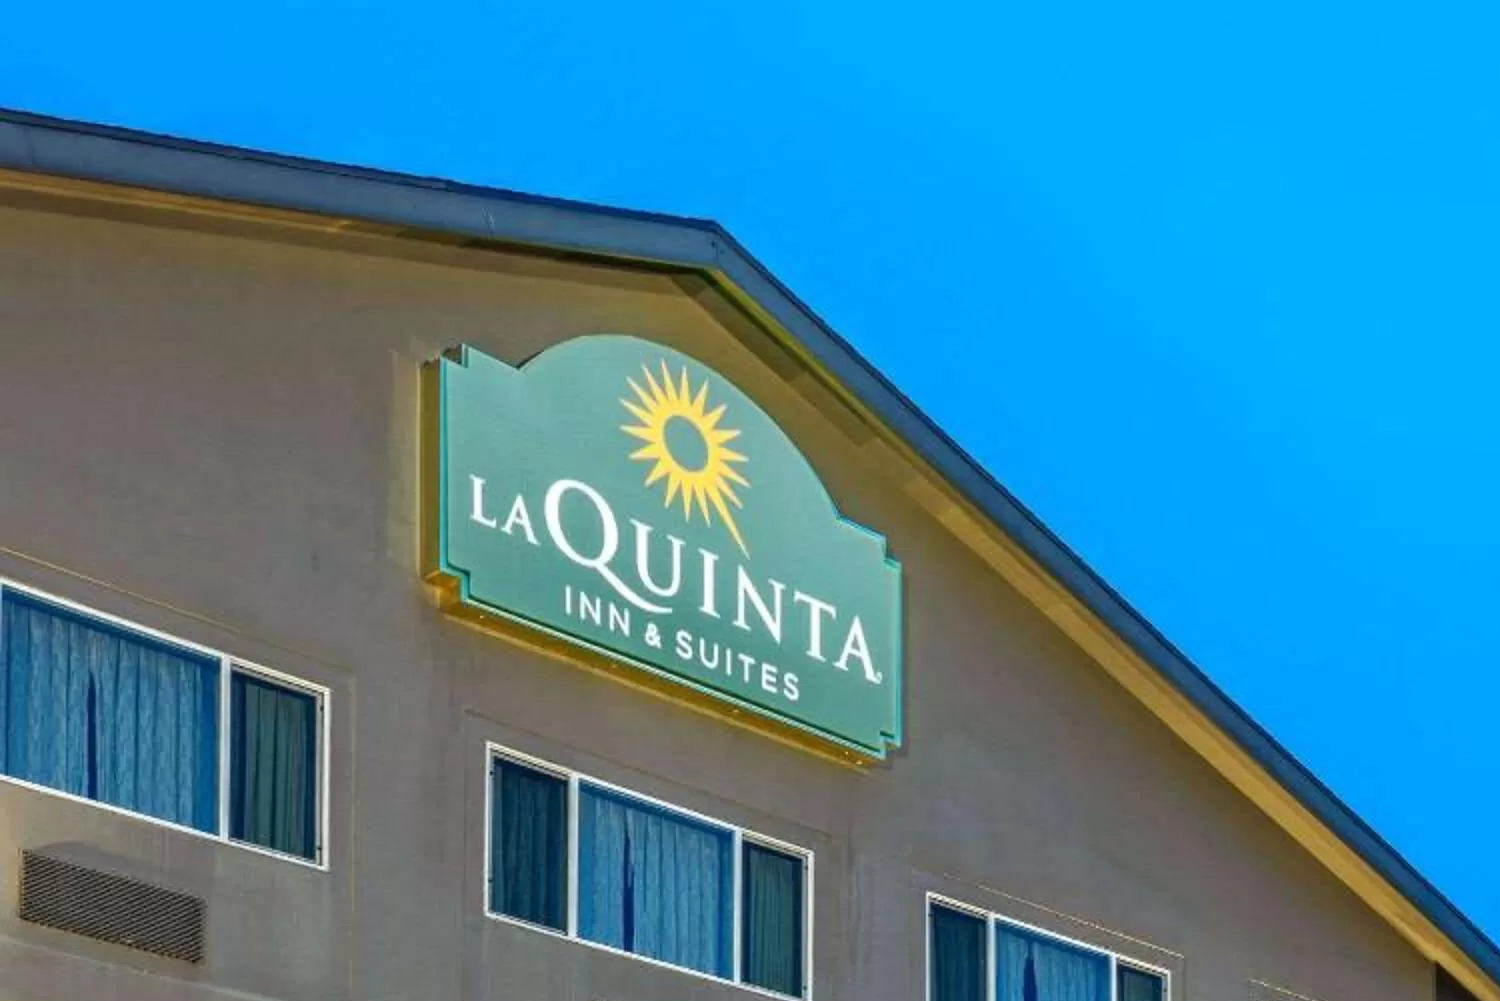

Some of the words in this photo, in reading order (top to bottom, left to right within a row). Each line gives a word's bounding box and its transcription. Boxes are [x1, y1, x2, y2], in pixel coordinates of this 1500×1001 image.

[469, 475, 540, 546] LA
[543, 478, 882, 684] QUINTA
[565, 586, 631, 637] INN
[644, 622, 662, 649] &
[675, 630, 801, 701] SUITES
